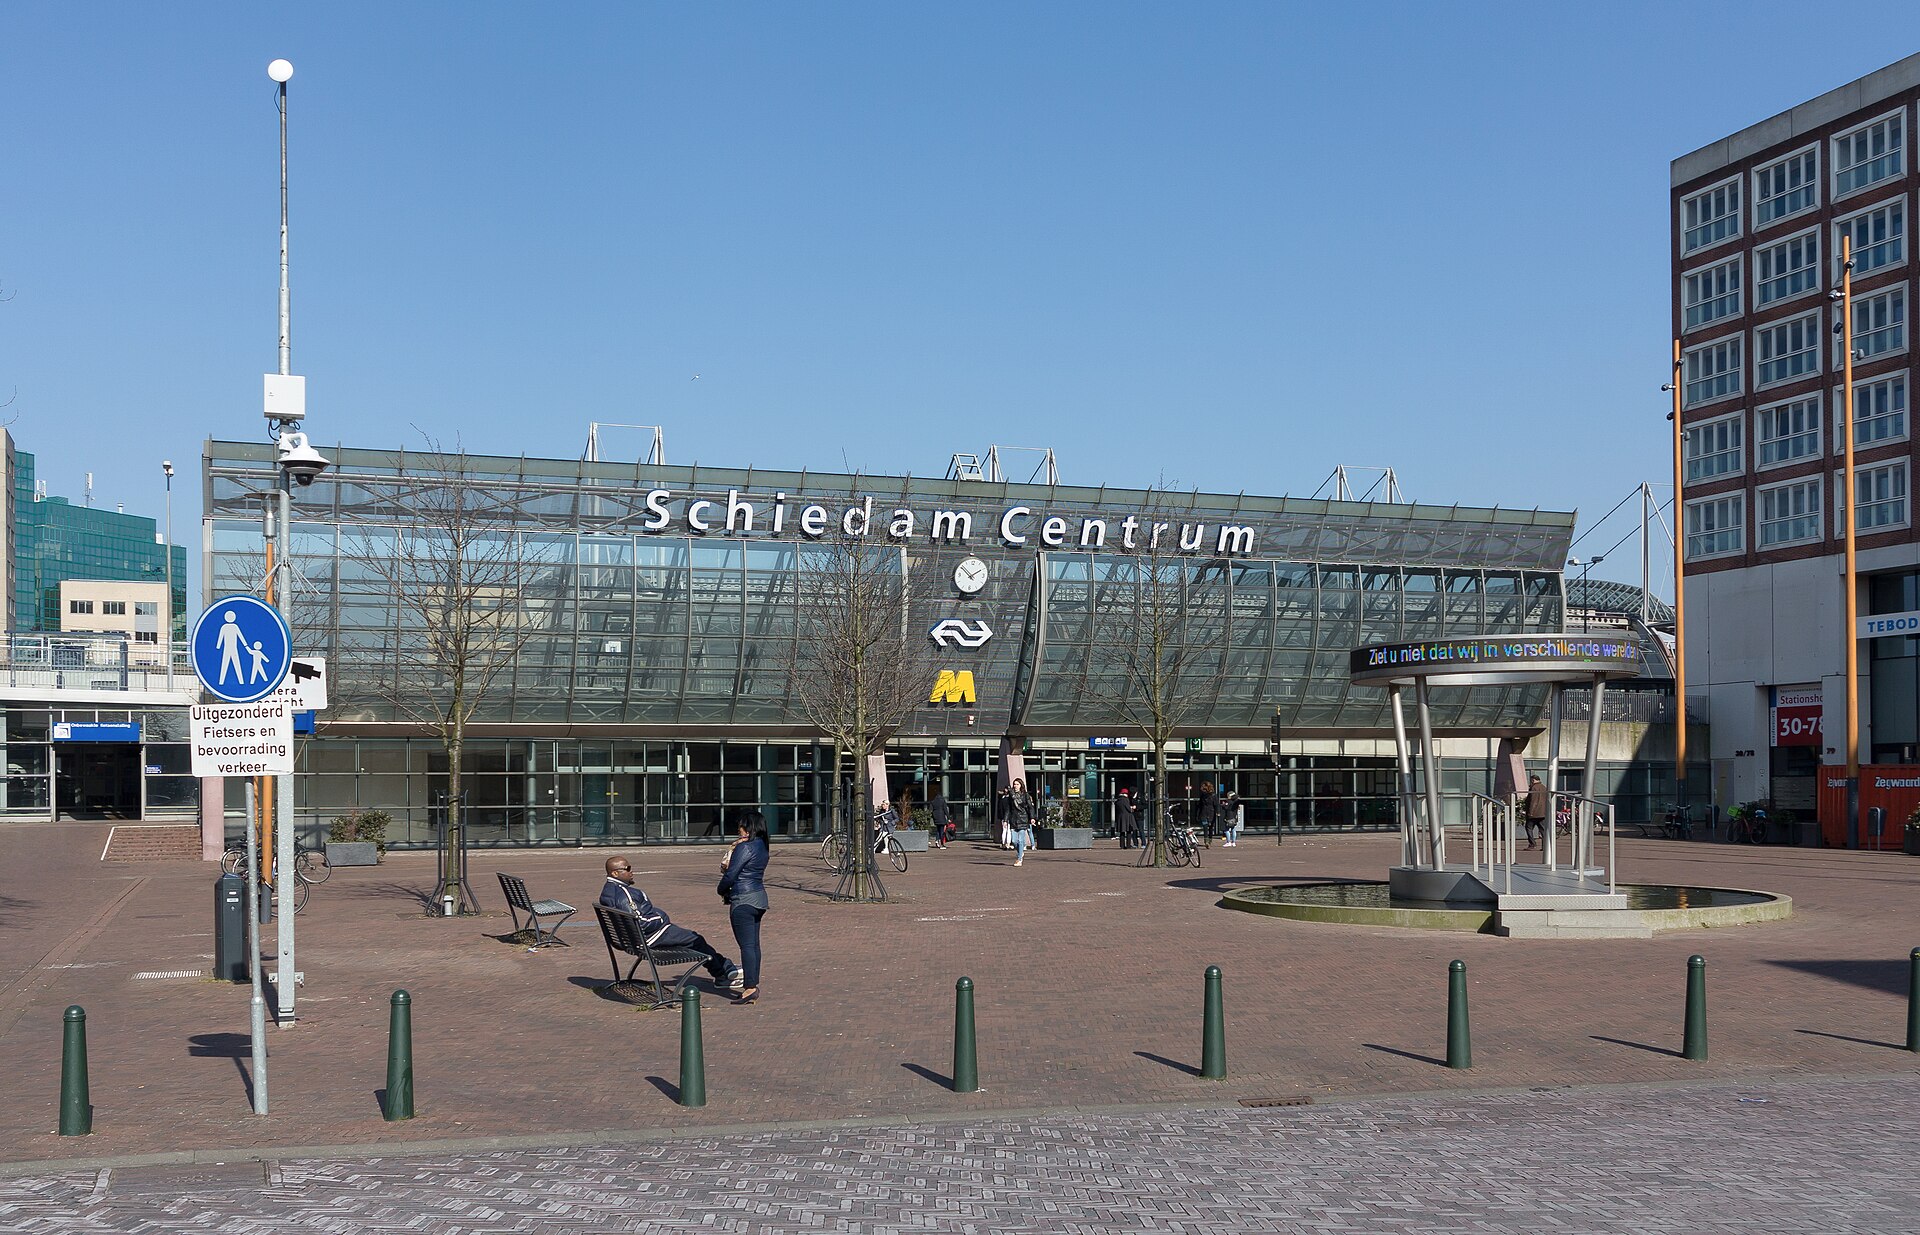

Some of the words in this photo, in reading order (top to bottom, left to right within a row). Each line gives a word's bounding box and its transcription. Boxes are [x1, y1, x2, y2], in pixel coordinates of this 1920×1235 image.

[644, 488, 972, 540] Schiedam
[1000, 506, 1255, 553] Centrum
[1867, 617, 1919, 633] TEBOD
[1369, 647, 1388, 666] Ziet
[1390, 650, 1397, 664] u
[1400, 645, 1426, 663] niet
[1429, 643, 1454, 661] dat
[1457, 641, 1479, 663] wij
[1484, 641, 1498, 658] in
[1503, 639, 1600, 657] verschillende
[192, 704, 283, 723] Uitgezonderd
[203, 726, 256, 738] Fietsers
[260, 727, 276, 737] en
[198, 742, 286, 757] bevoorrading
[217, 762, 267, 774] verkeer
